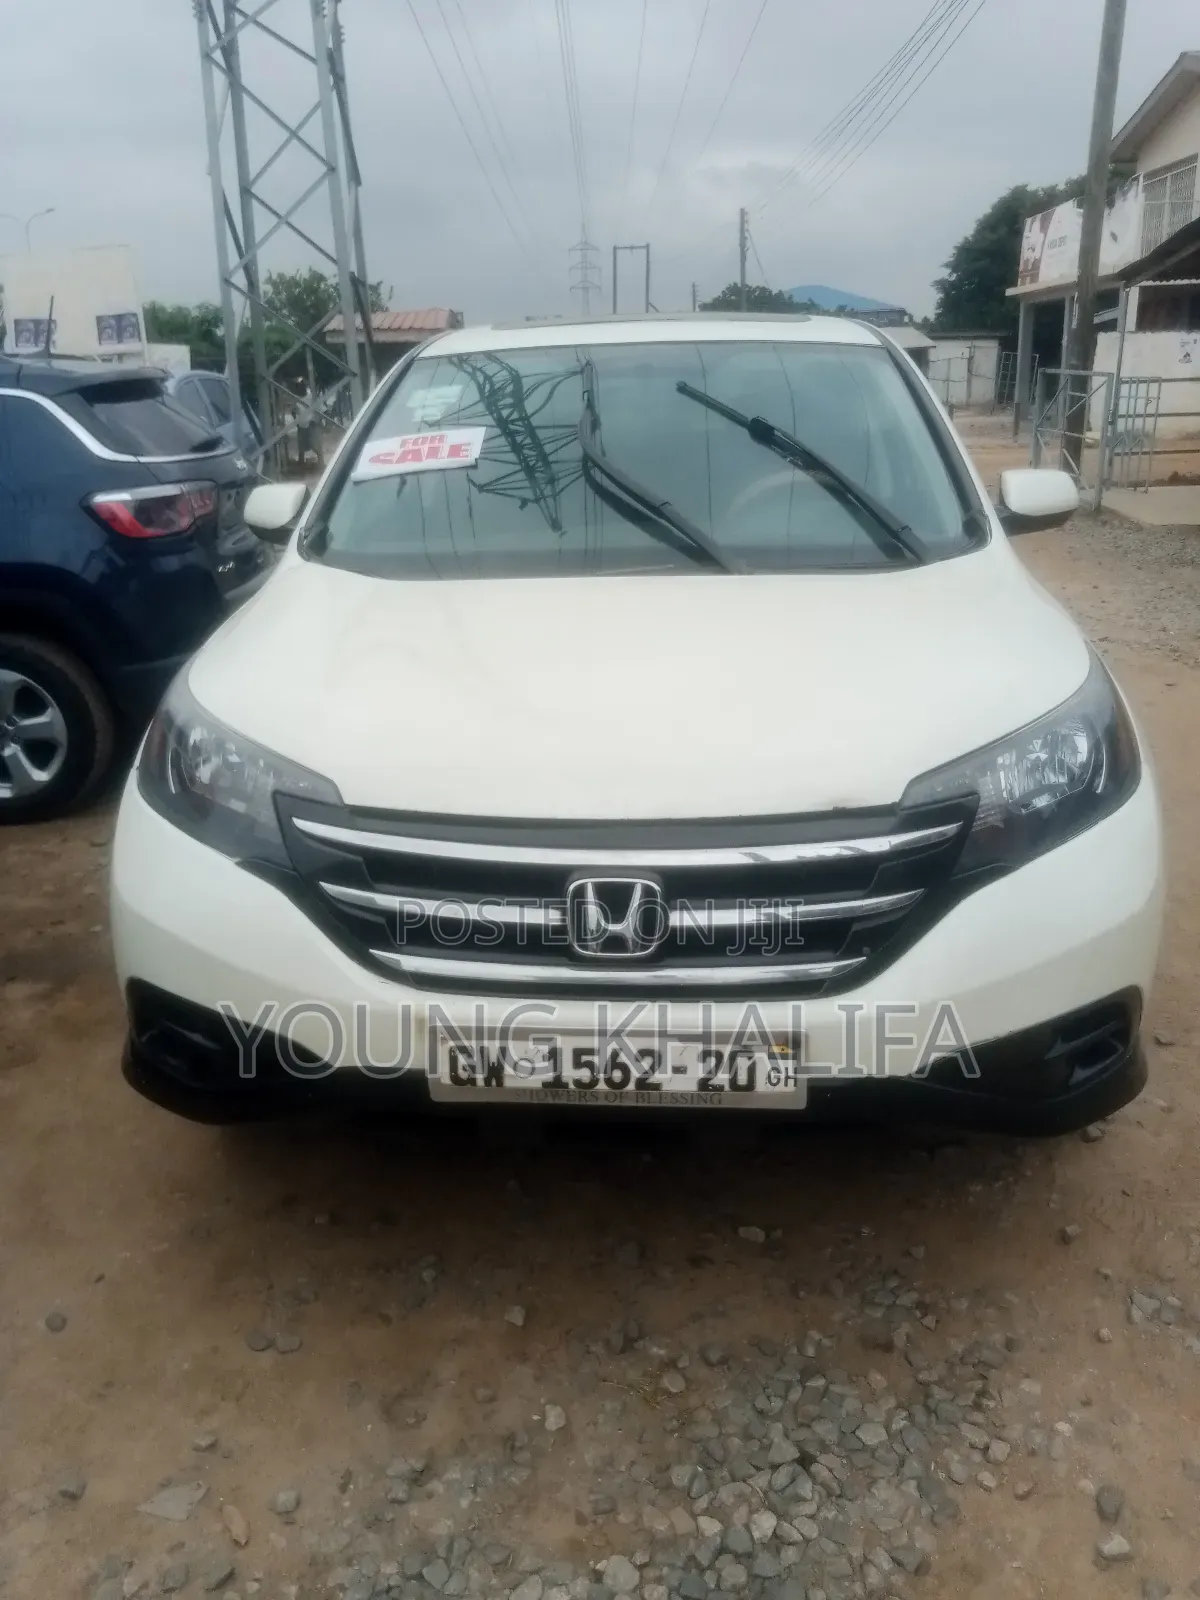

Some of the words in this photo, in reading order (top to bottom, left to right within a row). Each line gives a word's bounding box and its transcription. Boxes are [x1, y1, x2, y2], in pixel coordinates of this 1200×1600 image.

[400, 434, 448, 450] FOR
[368, 442, 472, 465] SALE
[449, 1045, 507, 1087] GW
[767, 1066, 798, 1088] GH
[604, 1090, 623, 1105] OF
[635, 1091, 723, 1106] BLESSING
